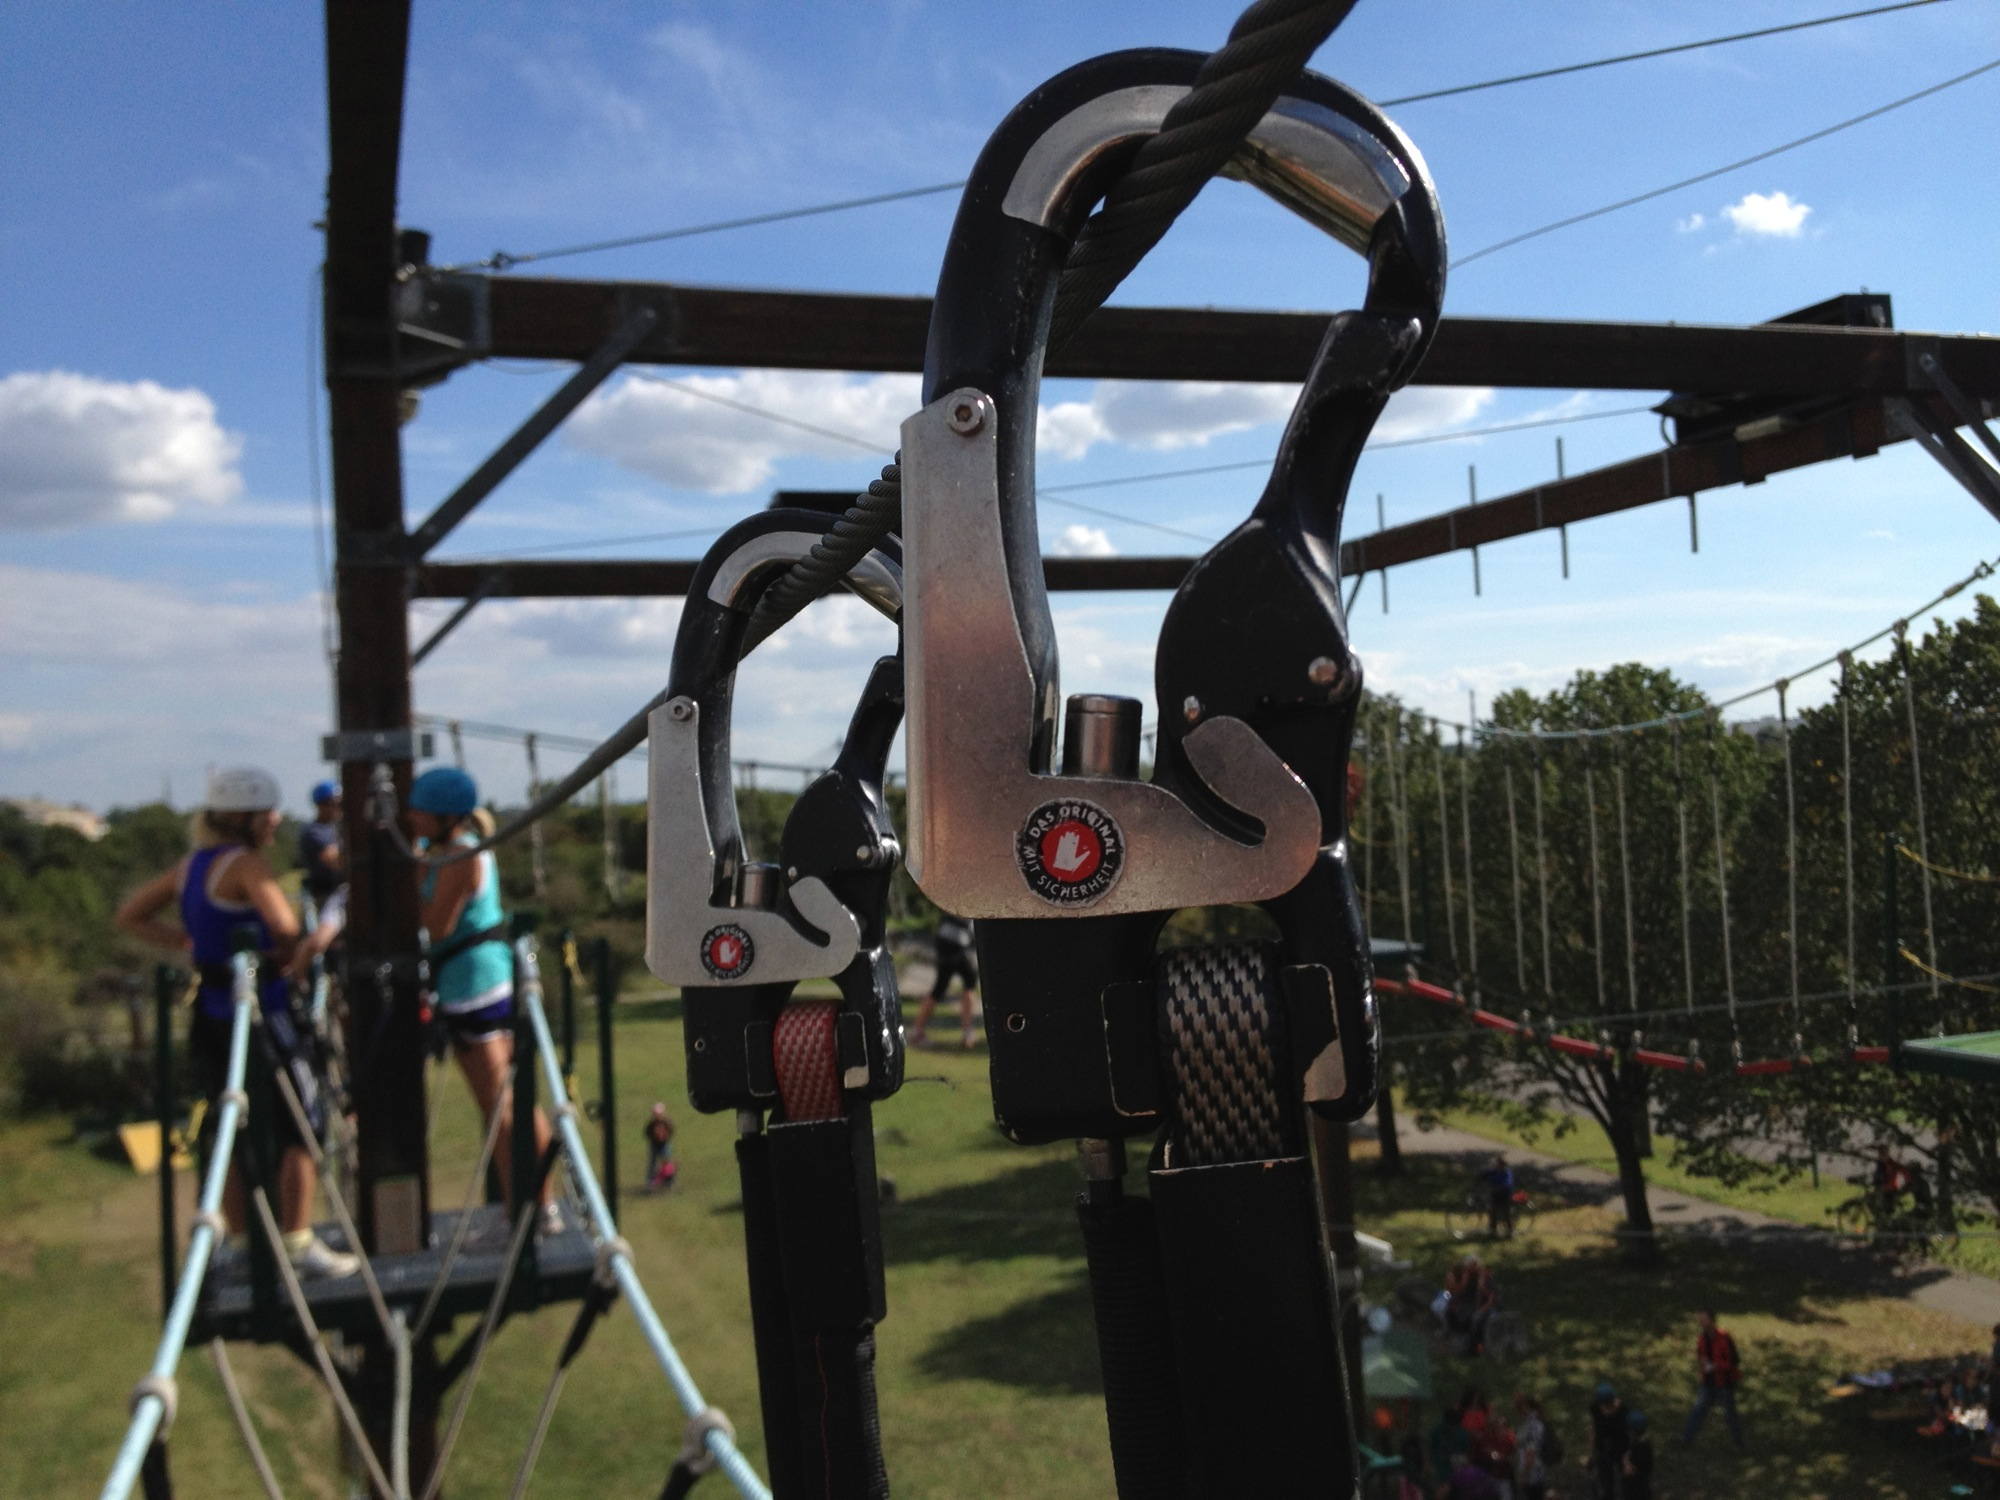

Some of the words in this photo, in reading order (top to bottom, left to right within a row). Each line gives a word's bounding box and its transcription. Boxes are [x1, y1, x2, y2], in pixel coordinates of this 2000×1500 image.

[1030, 811, 1055, 839] DAS
[1059, 806, 1116, 855] ORIGINAL
[1023, 846, 1041, 872] MIT
[1037, 862, 1114, 898] SICHERHEIT
